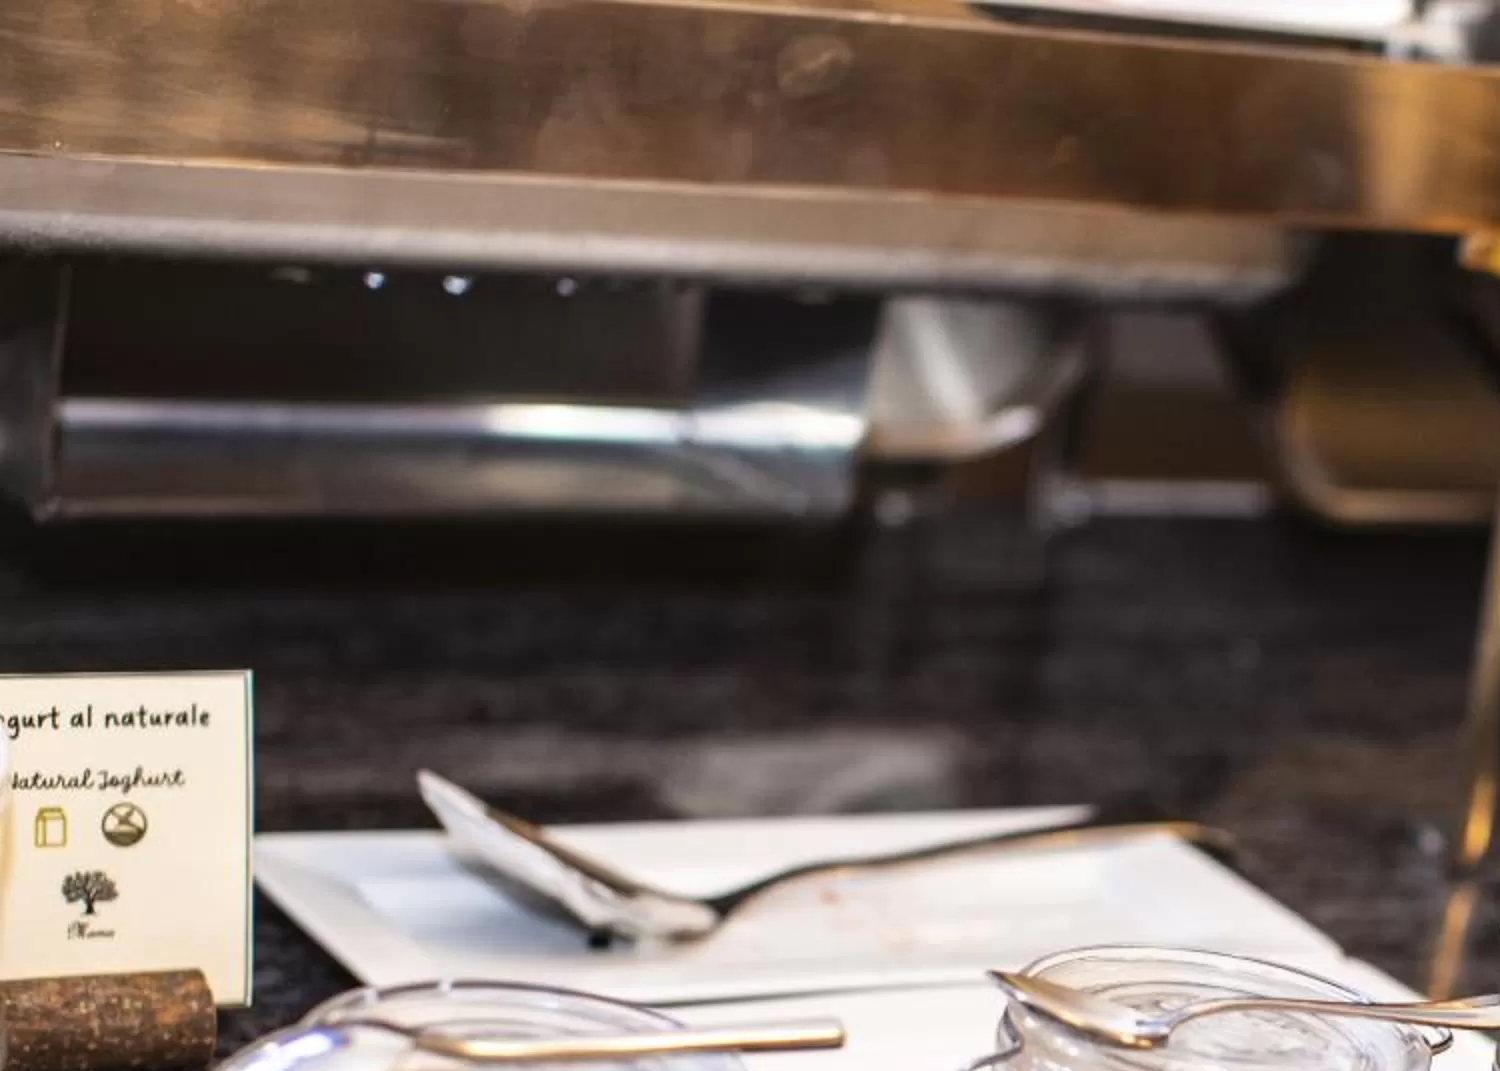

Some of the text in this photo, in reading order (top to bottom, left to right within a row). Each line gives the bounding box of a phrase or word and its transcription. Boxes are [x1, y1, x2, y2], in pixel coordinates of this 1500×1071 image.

[0, 703, 211, 741] gurt al naturale
